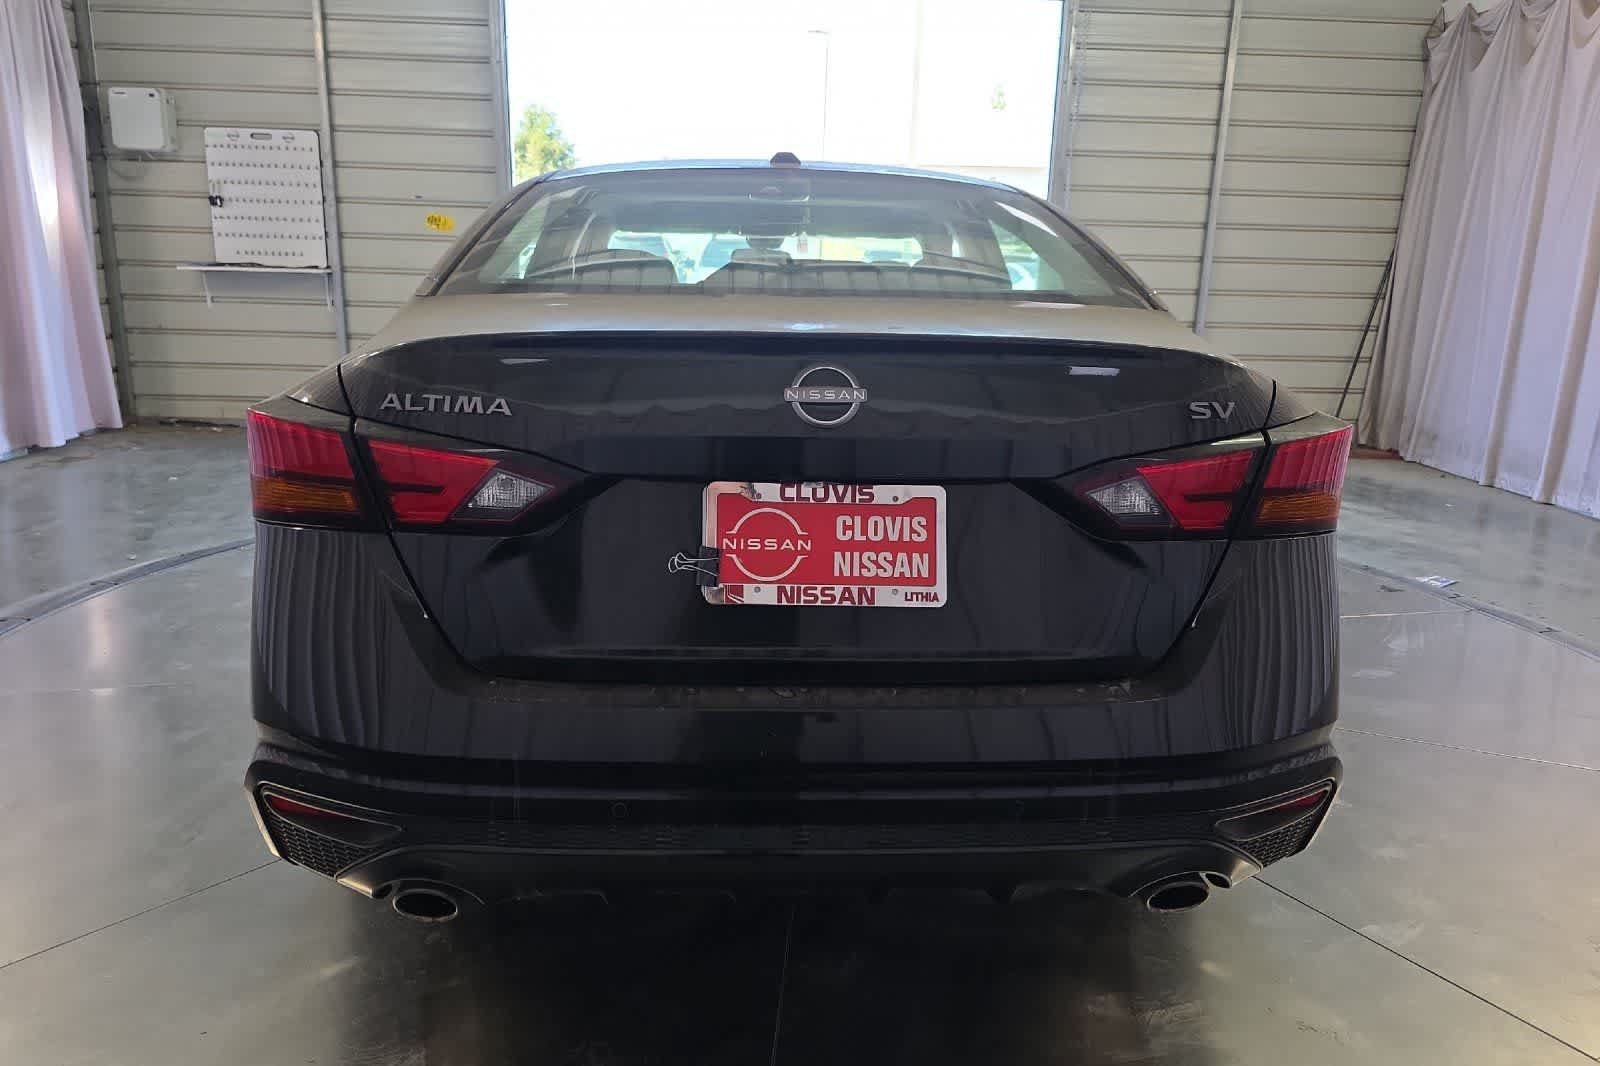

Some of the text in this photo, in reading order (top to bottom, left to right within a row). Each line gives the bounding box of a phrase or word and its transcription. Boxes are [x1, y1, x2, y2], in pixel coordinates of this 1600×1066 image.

[380, 393, 512, 416] ALTIMA
[786, 390, 865, 400] NISSAN
[1190, 402, 1235, 419] SV
[780, 483, 875, 503] CLOVIS
[835, 515, 928, 542] CLOVIS
[722, 538, 812, 551] NISSAN
[833, 551, 929, 578] NISSAN
[776, 585, 876, 605] NISSAN
[904, 591, 940, 603] LITHIA
